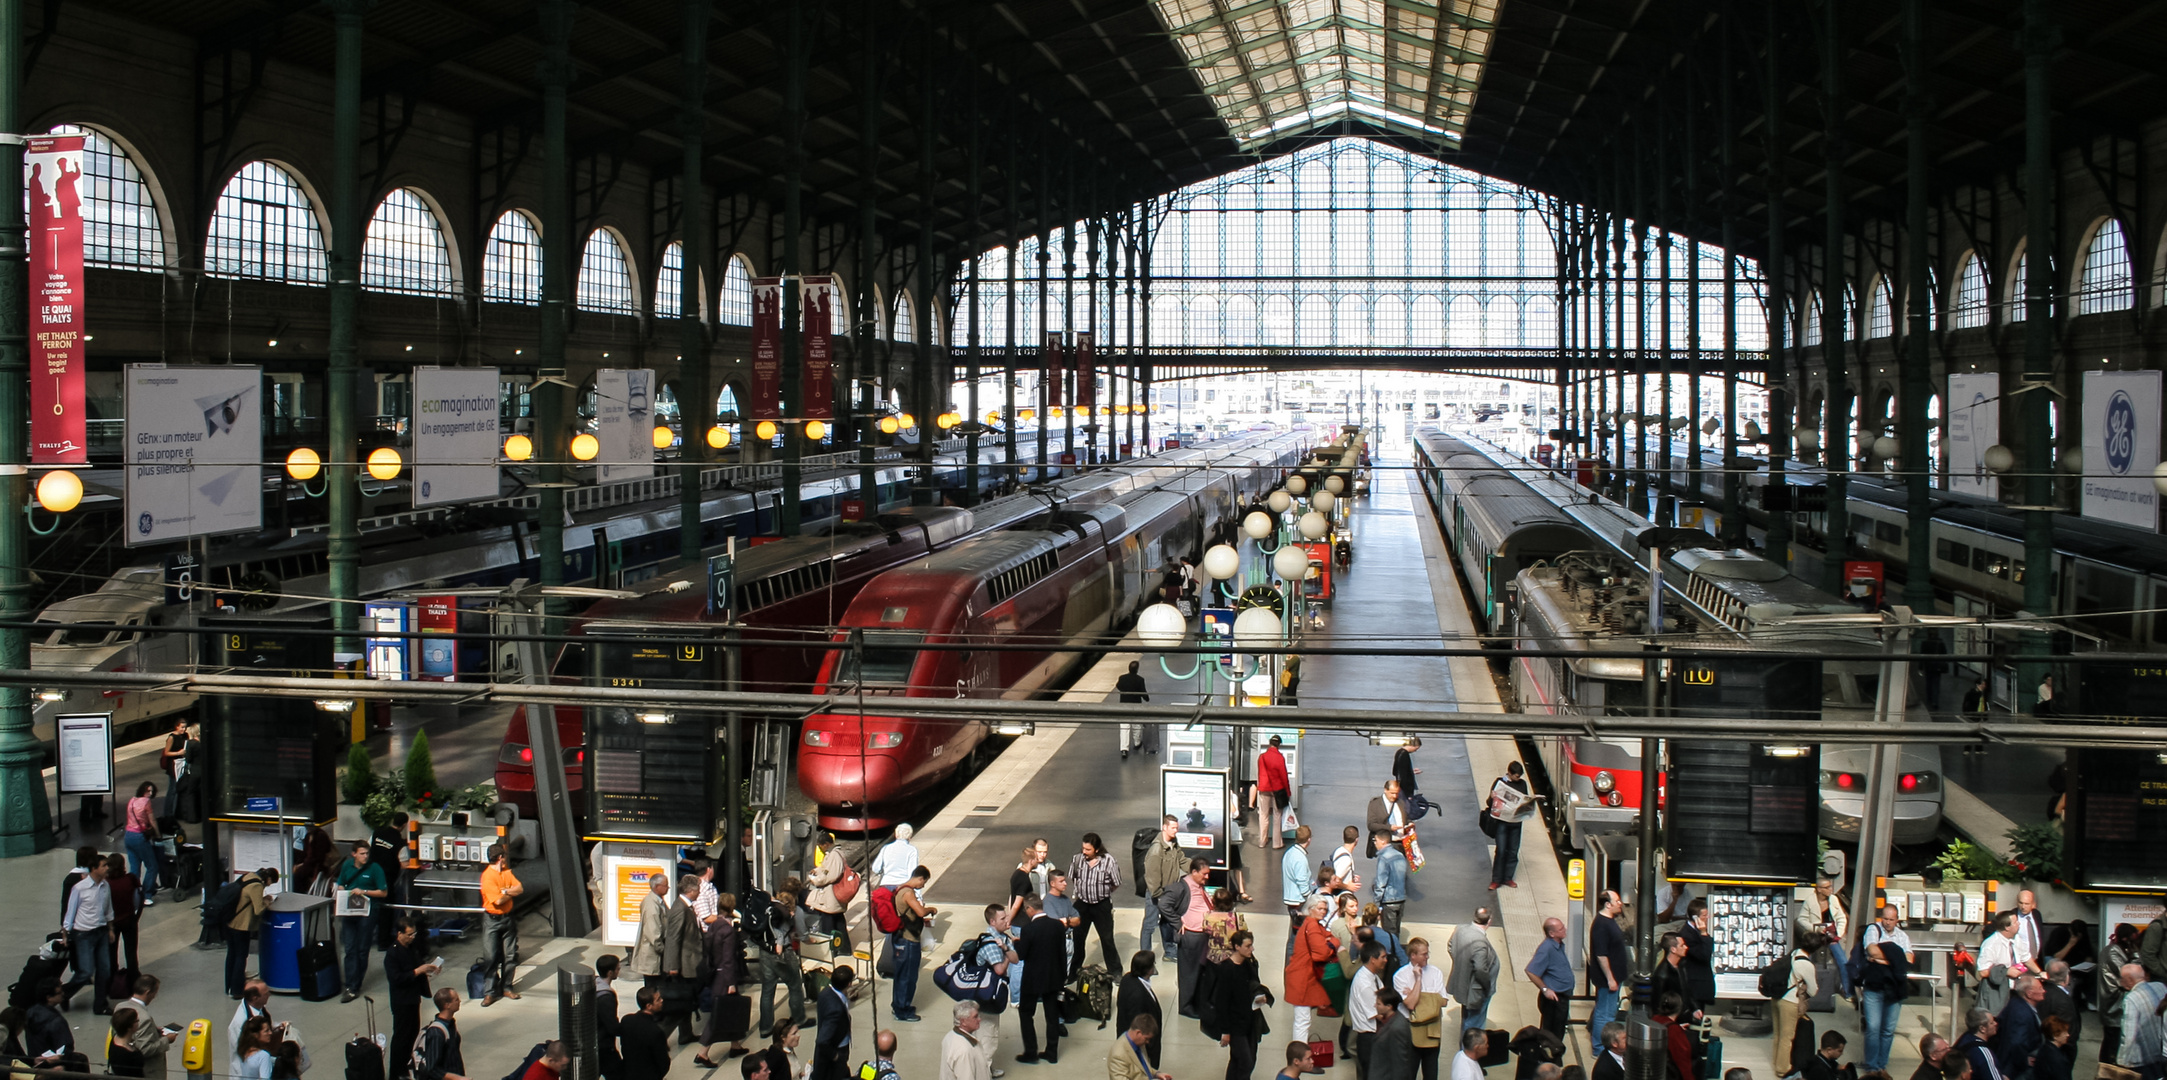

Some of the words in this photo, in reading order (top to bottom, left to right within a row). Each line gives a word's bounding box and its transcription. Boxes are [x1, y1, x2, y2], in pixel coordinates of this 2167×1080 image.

[42, 306, 50, 314] LE
[52, 305, 72, 314] QUAI
[42, 314, 72, 324] THALYS
[37, 332, 49, 340] HET
[51, 332, 77, 340] THALYS
[42, 340, 72, 349] PERRON
[422, 394, 495, 416] ecomagination
[422, 422, 431, 434] Un
[433, 421, 475, 437] engagement
[477, 419, 484, 431] de
[486, 419, 495, 431] GE
[175, 432, 203, 442] moteur
[137, 448, 154, 462] plus
[156, 449, 184, 461] propre
[186, 447, 194, 457] et
[137, 464, 154, 479] plus
[156, 463, 195, 475] silencieux
[2086, 483, 2093, 496] GE
[2094, 486, 2128, 501] imagination
[2130, 491, 2136, 502] at
[2138, 492, 2154, 505] work
[177, 555, 194, 564] Voie
[179, 572, 192, 600] 8
[718, 578, 726, 608] 9
[232, 635, 240, 649] 8
[685, 645, 695, 658] 9
[1690, 669, 1710, 682] 10
